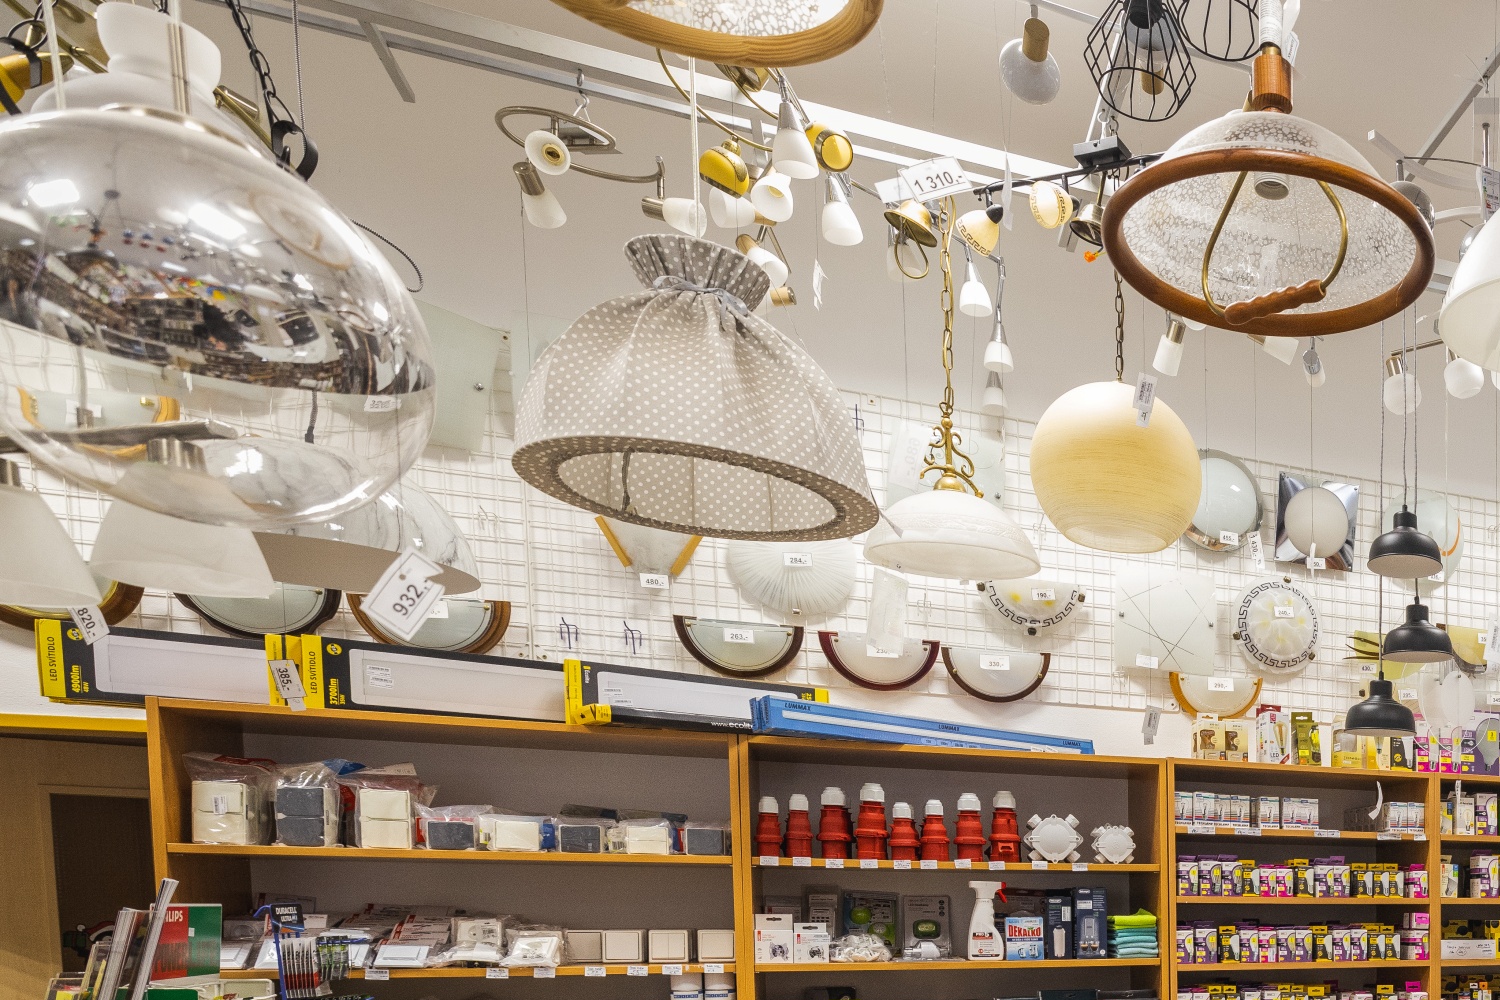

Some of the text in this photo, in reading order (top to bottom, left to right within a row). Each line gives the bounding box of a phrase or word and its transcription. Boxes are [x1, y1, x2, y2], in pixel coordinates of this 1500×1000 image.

[913, 171, 964, 192] 1 310,-
[789, 556, 808, 564] 284,-
[645, 577, 666, 586] 480,-
[392, 579, 429, 616] 932,-
[77, 607, 97, 638] 820,-
[730, 633, 749, 641] 263,-
[48, 636, 58, 682] LED SVÍTIDLO
[310, 650, 318, 685] SVÍTIDLO
[70, 664, 80, 693] 4900lm
[82, 681, 90, 693] 48W
[278, 667, 293, 691] 385,-
[329, 677, 338, 705] 3700lm
[784, 702, 812, 712] LUMMAX
[938, 723, 960, 733] LUMMAX
[275, 905, 298, 915] DURACELL
[1008, 924, 1042, 938] DEKALKO
